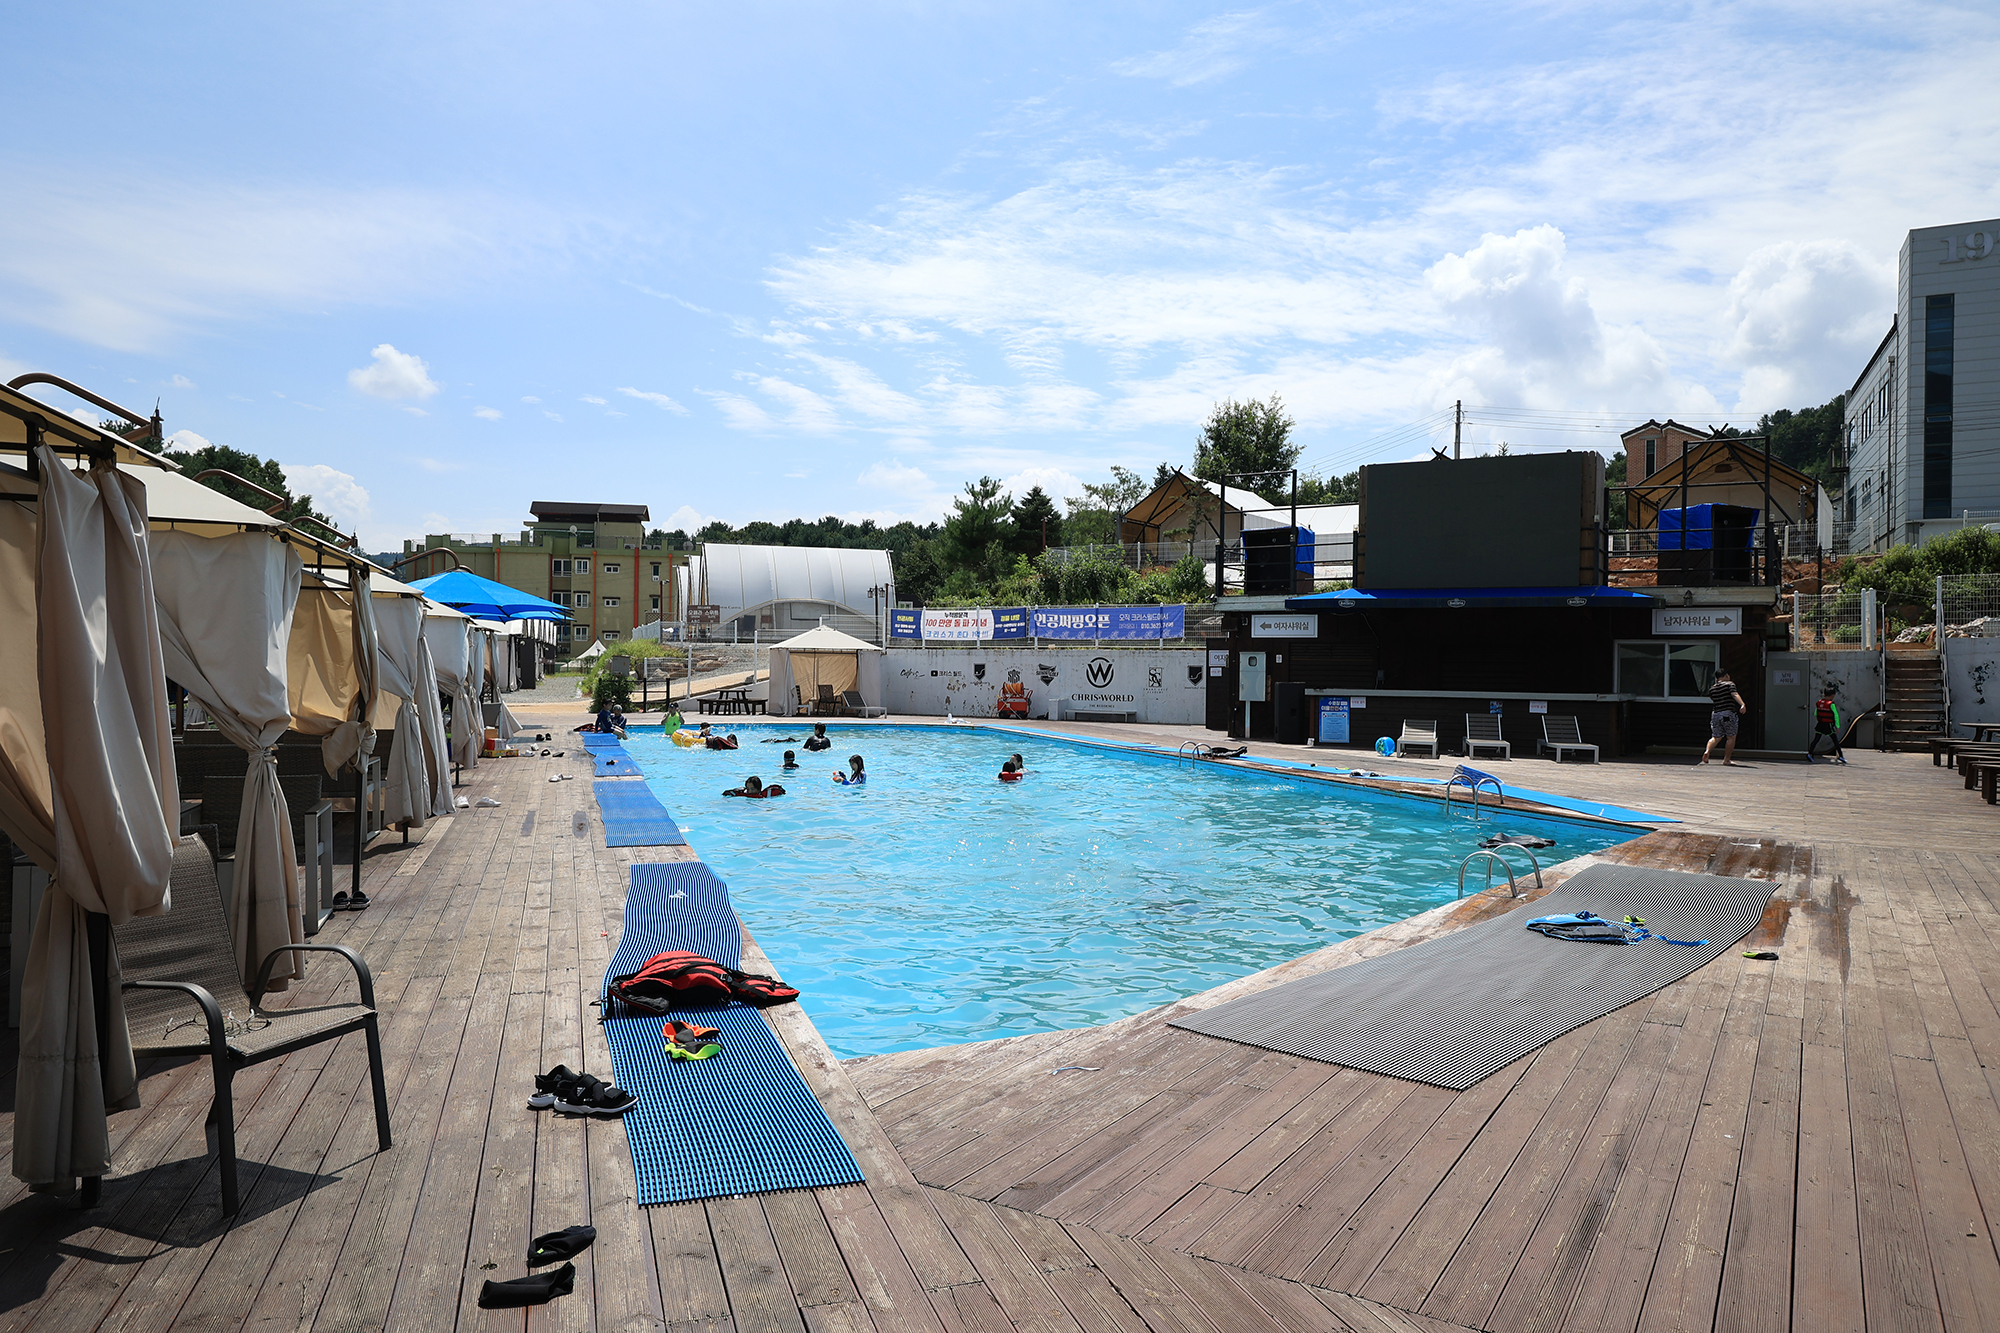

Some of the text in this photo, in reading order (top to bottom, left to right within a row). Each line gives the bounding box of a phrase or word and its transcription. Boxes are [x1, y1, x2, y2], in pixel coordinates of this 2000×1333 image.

[1939, 230, 2000, 265] 19
[925, 618, 938, 627] 100
[1033, 612, 1111, 629] 인공써핑오픈
[1118, 613, 1130, 621] 오직
[1663, 615, 1711, 627] 남자샤워실
[1273, 621, 1310, 631] 여자샤워실
